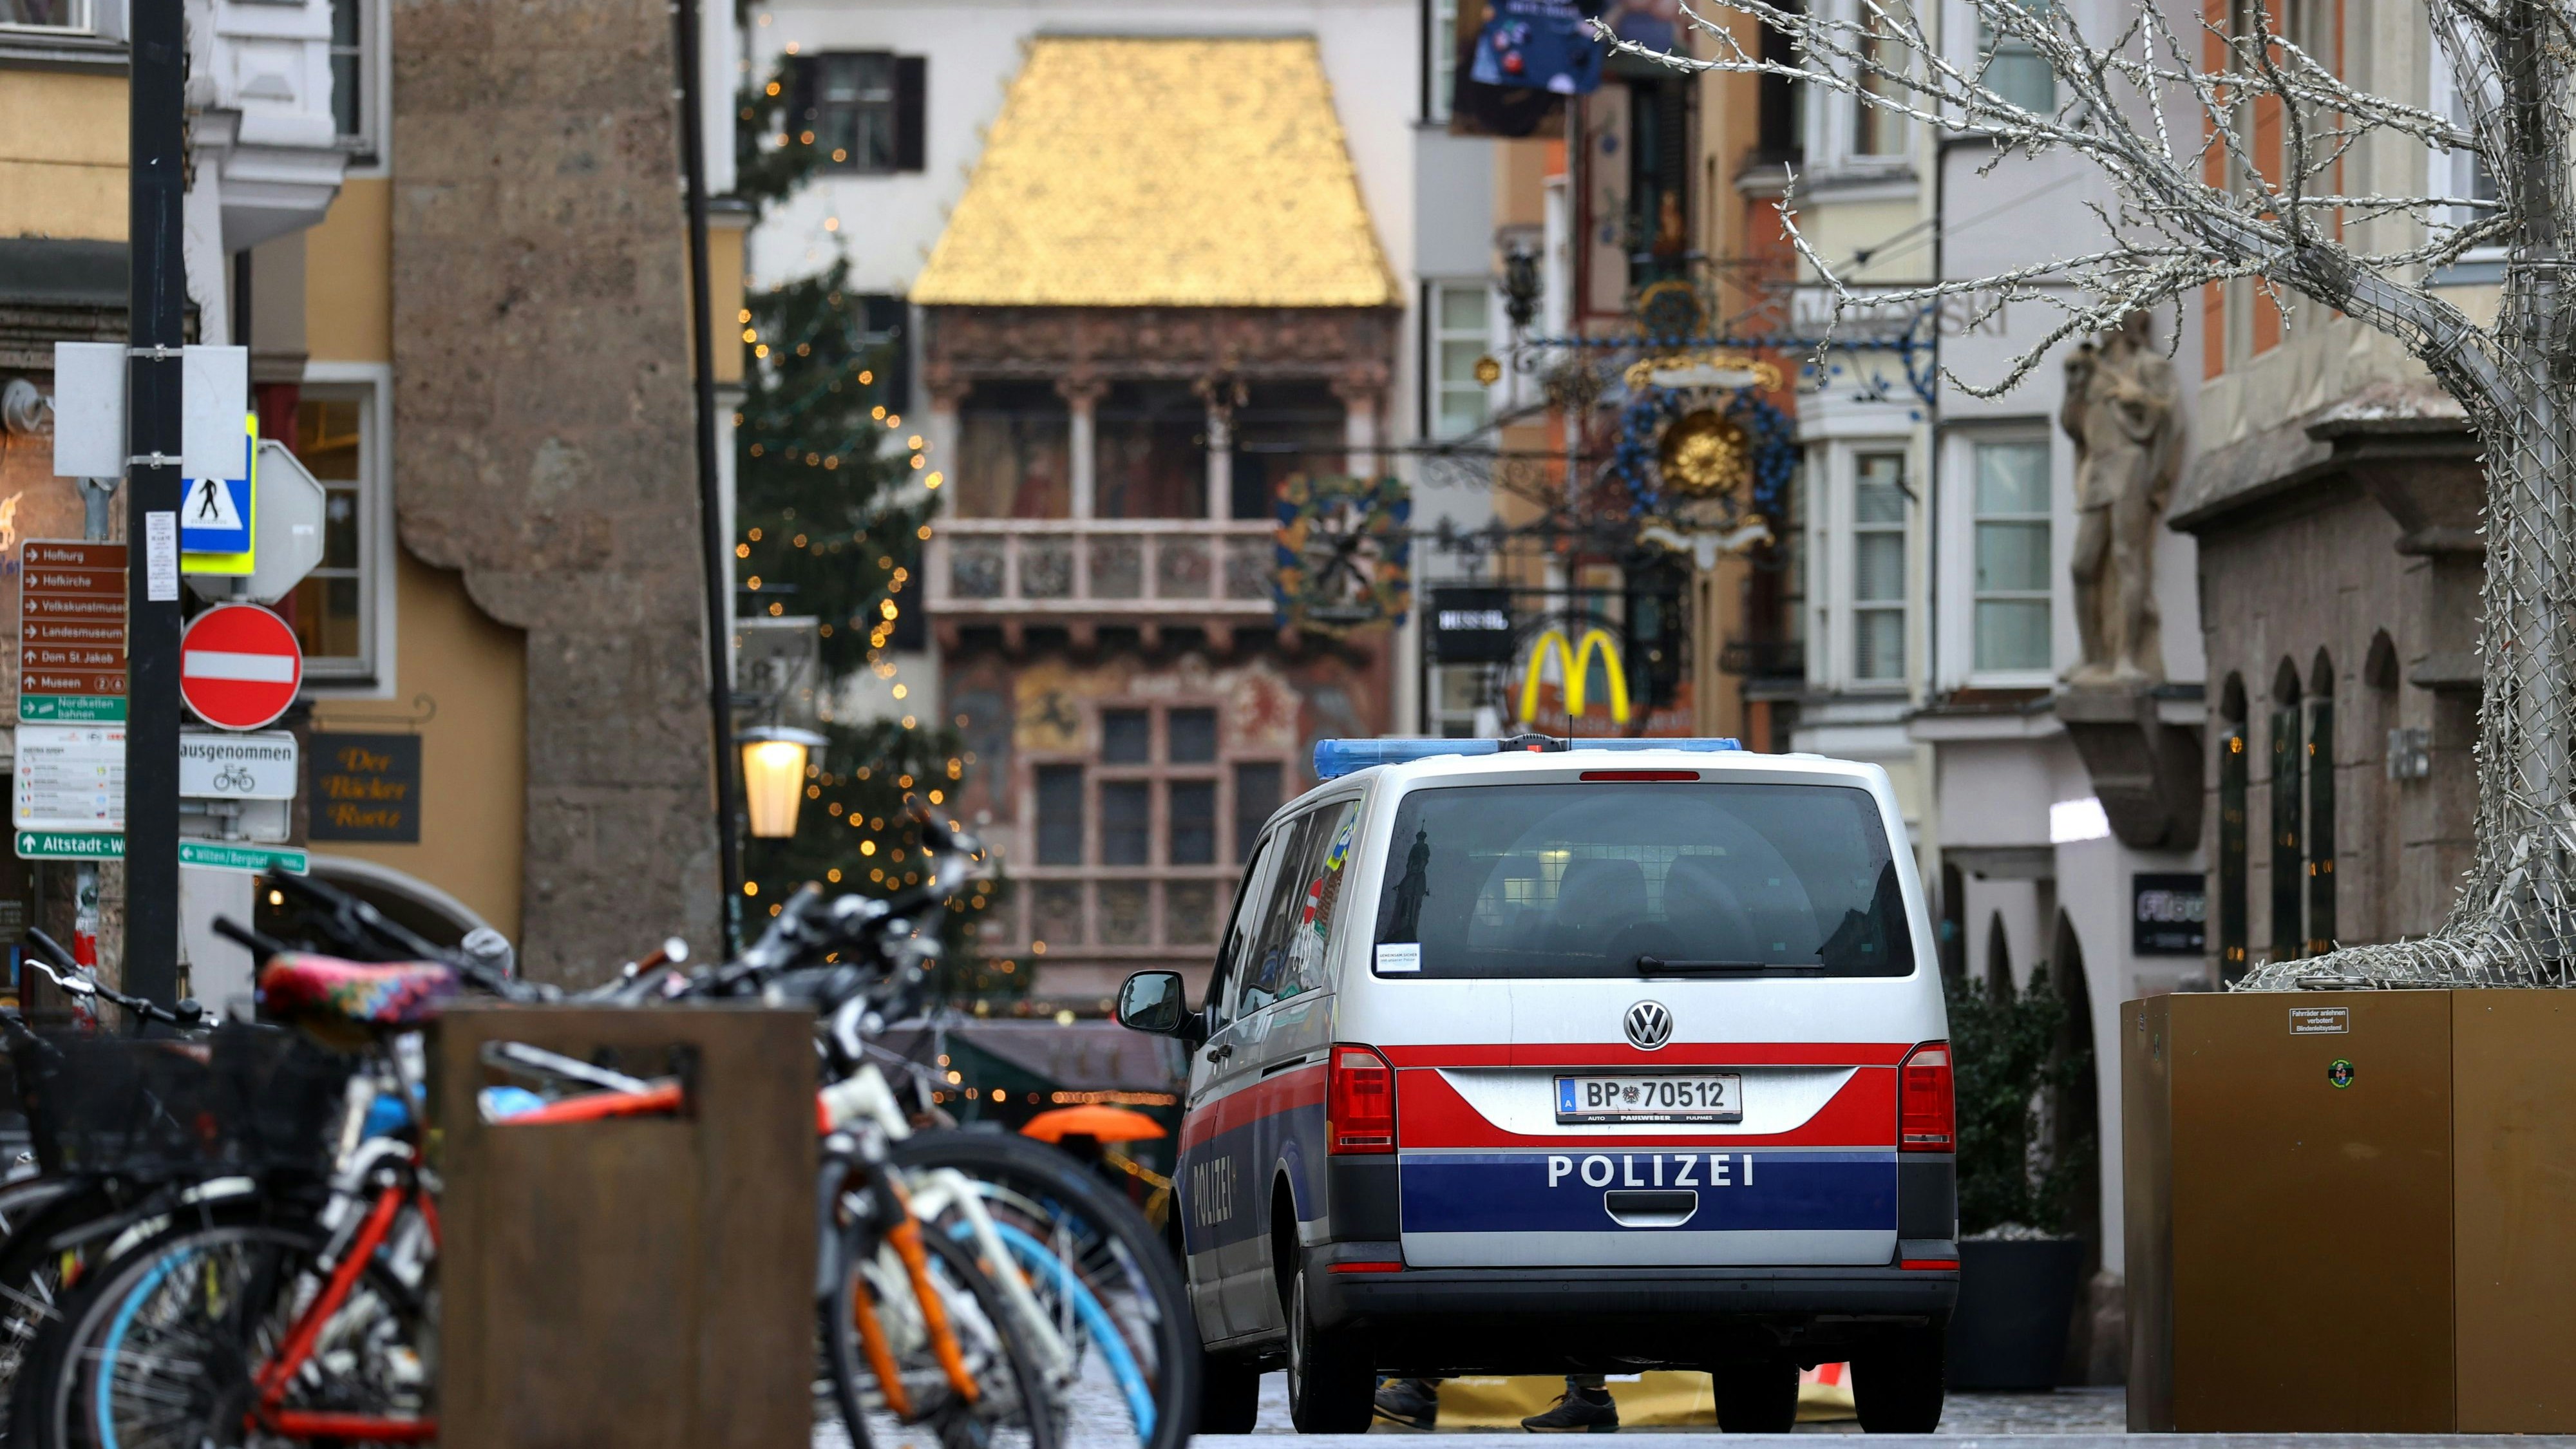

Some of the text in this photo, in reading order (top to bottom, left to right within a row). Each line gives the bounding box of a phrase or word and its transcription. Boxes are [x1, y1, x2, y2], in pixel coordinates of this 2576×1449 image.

[43, 549, 84, 564] Hofburg
[43, 573, 91, 587] Hofkirche
[43, 600, 126, 614] Volkskunstmuse
[42, 625, 122, 639] Landesmuseum
[42, 650, 114, 665] Dom St. Jakob
[41, 676, 81, 688] Museen
[58, 696, 114, 709] Nordketten
[58, 709, 95, 719] bahnen
[180, 744, 292, 762] ausgenommen
[43, 835, 126, 854] Altstadt-W
[1587, 1082, 1724, 1107] BP 70512
[1564, 1099, 1573, 1108] A
[1548, 1154, 1754, 1188] POLIZEI
[1193, 1155, 1233, 1227] POLIZEI
